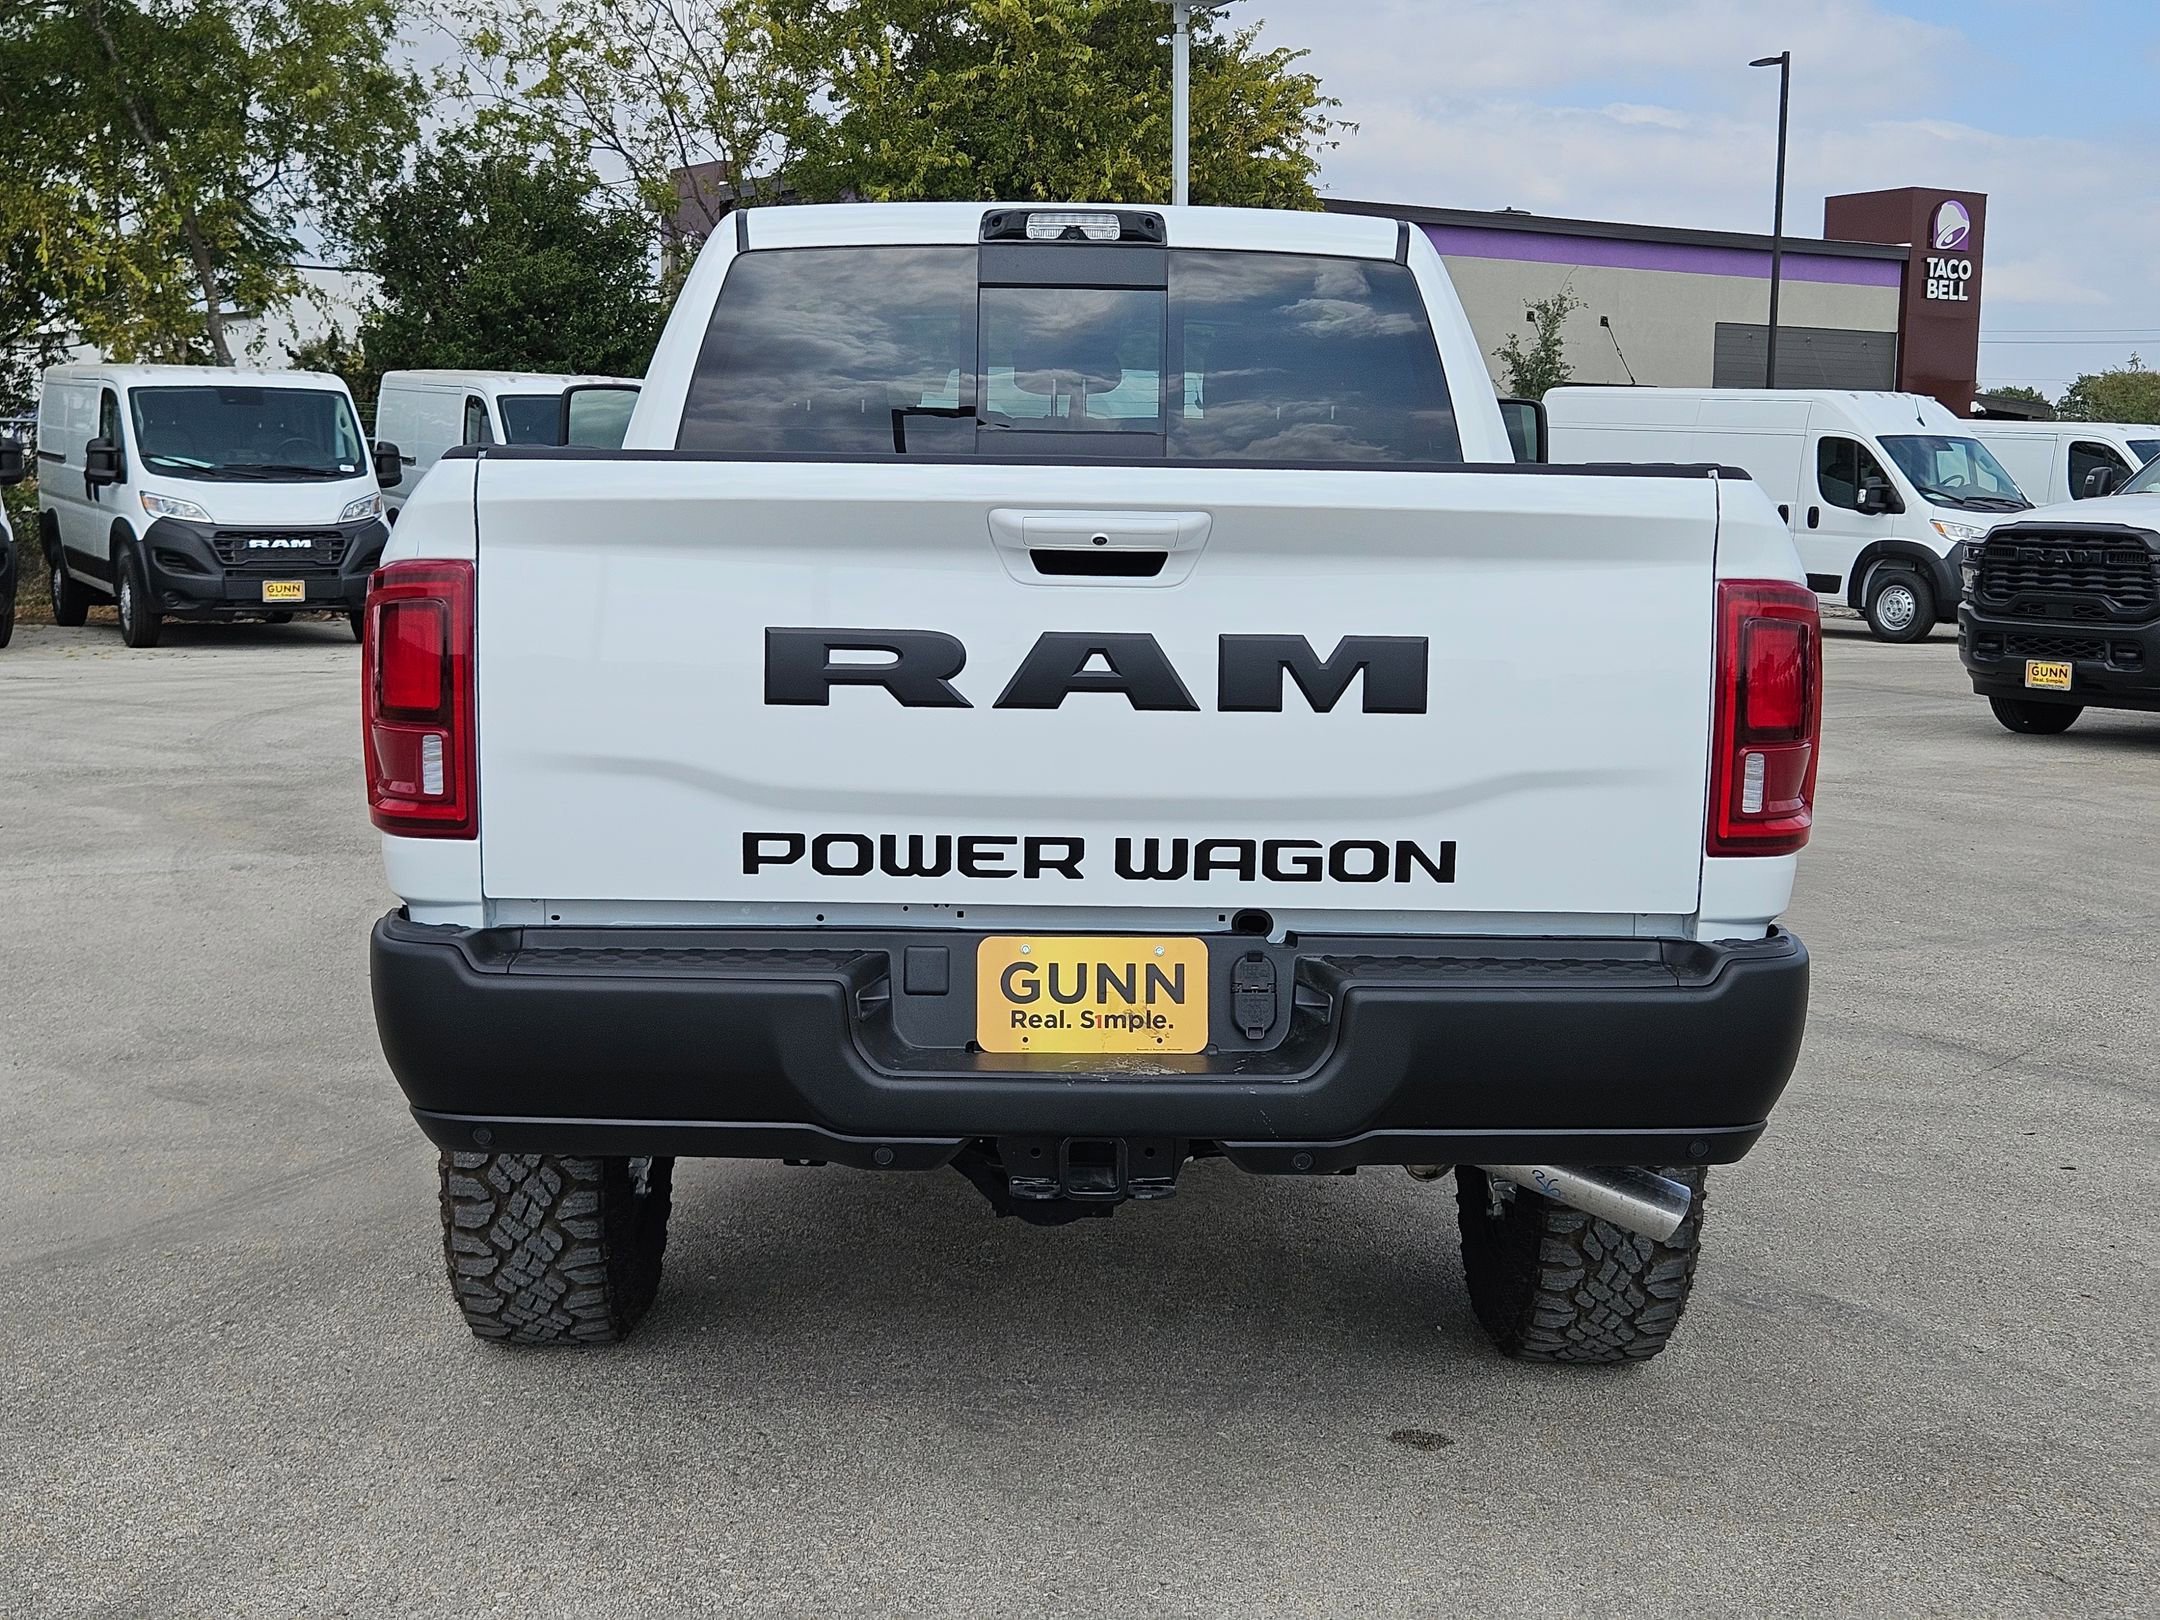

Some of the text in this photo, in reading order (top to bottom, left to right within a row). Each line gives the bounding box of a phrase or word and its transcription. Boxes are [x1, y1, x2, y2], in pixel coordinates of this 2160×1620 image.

[1926, 257, 1972, 280] TACO
[1926, 278, 1969, 301] BELL
[248, 539, 312, 549] RAM
[266, 584, 301, 593] GUNN
[764, 626, 1429, 714] RAM
[2031, 665, 2068, 679] GUNN
[742, 831, 1457, 883] POWER WAGON
[1000, 961, 1186, 1006] GUNN
[1010, 1009, 1072, 1030] Real.
